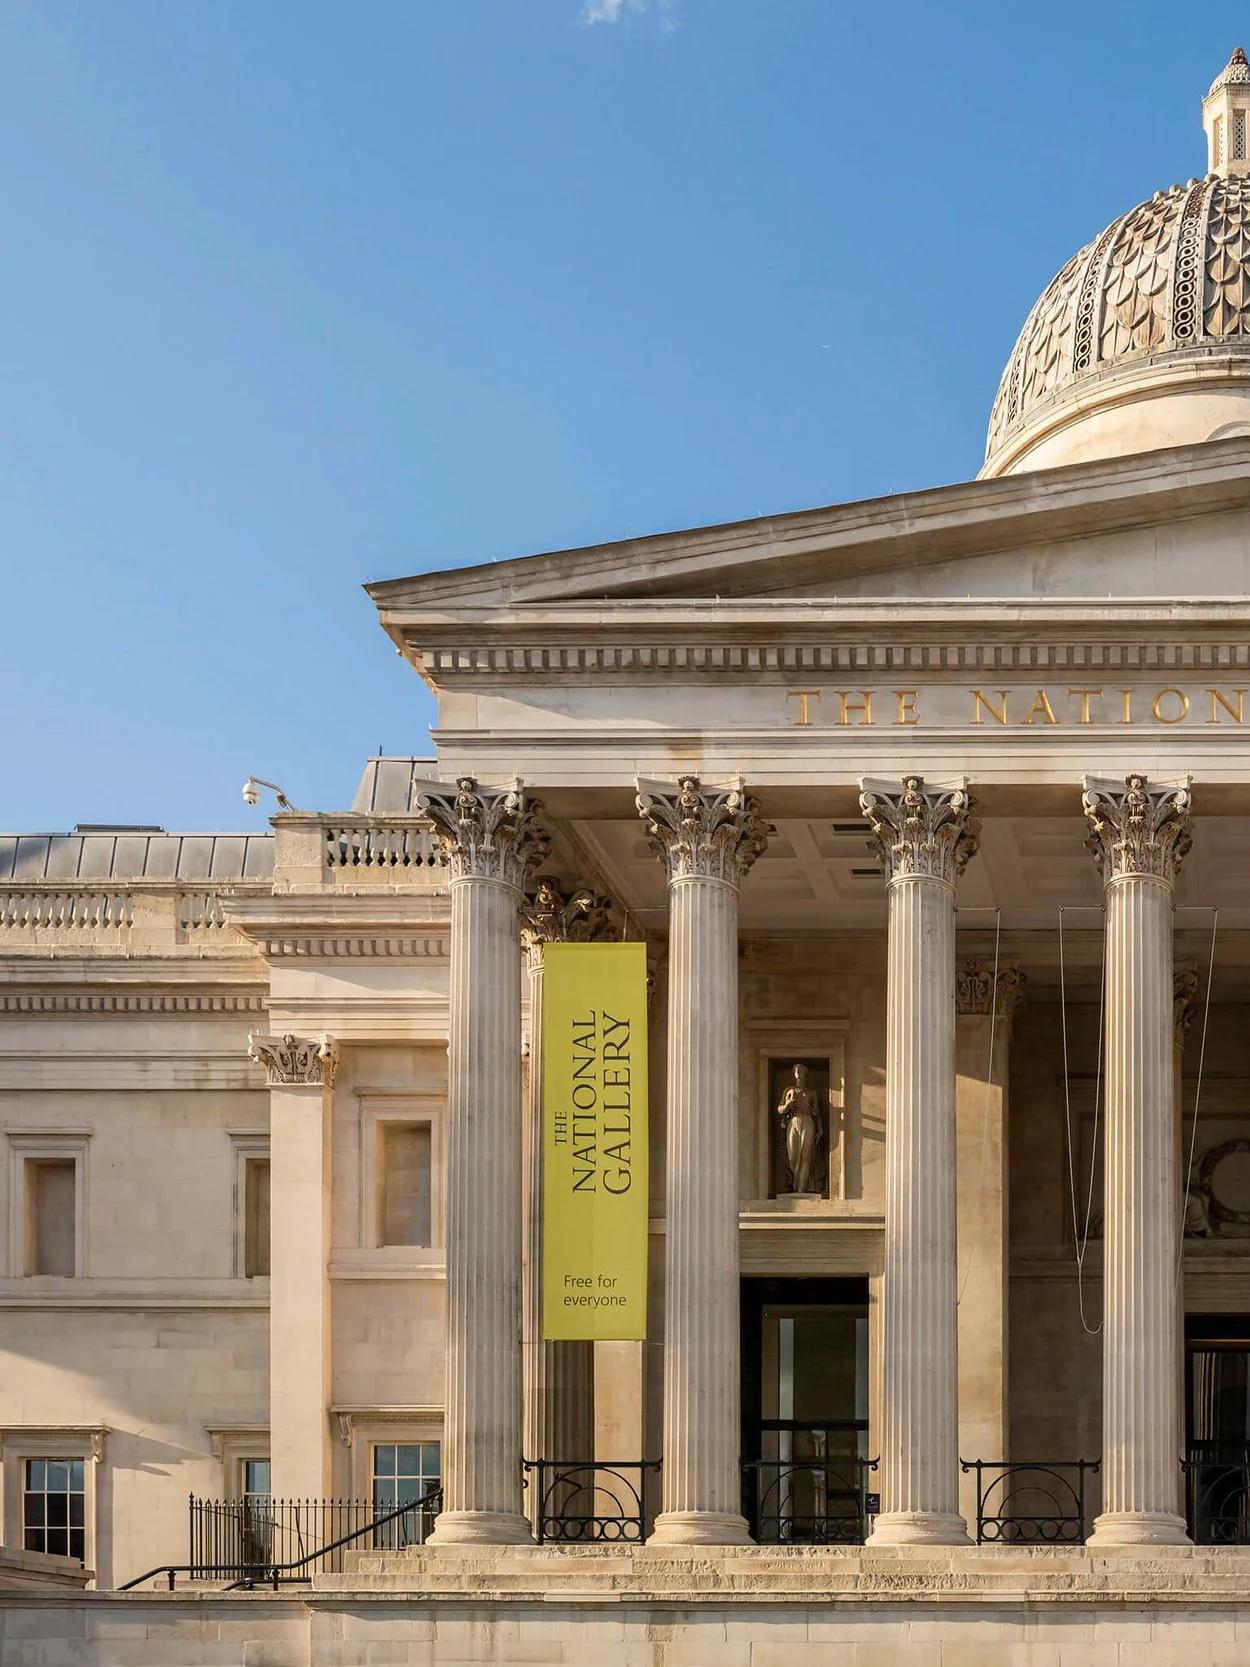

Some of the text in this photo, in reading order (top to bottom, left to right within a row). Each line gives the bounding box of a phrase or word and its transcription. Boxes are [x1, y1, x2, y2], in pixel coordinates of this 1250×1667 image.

[785, 689, 921, 726] THE
[572, 1009, 597, 1194] NATIONAL
[603, 1010, 631, 1195] GALLERY
[555, 1111, 567, 1146] THE
[564, 1274, 617, 1288] Free for
[563, 1293, 627, 1308] everyone
